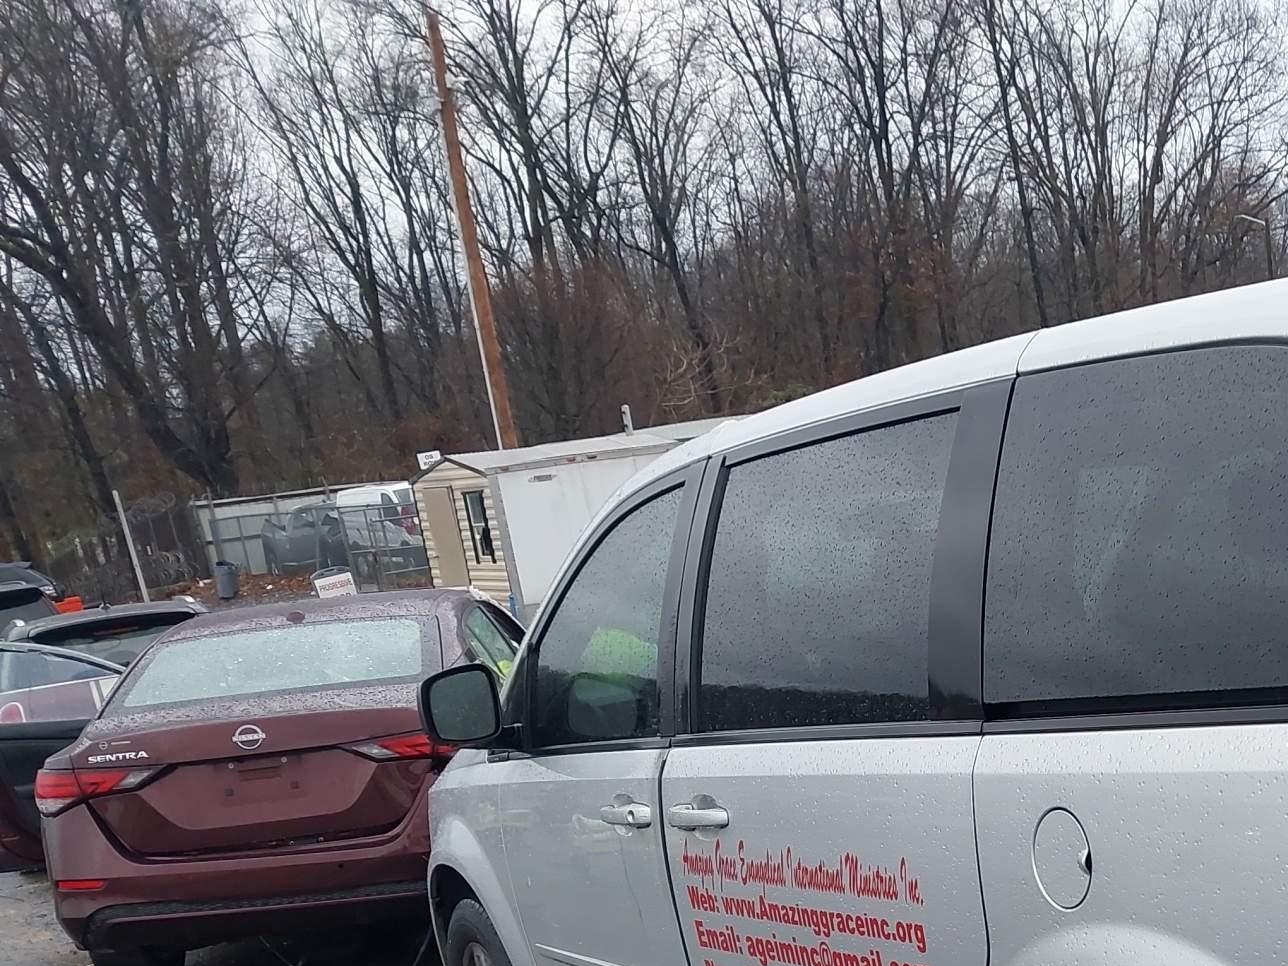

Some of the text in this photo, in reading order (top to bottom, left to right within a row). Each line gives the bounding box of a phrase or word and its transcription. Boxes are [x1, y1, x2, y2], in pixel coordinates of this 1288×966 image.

[87, 750, 150, 764] SENTRA
[683, 837, 923, 907] Amazing Grace Evangelical International Ministries Inc.
[687, 885, 927, 953] Web: www.Amazinggraceinc.org
[695, 920, 743, 955] Email:
